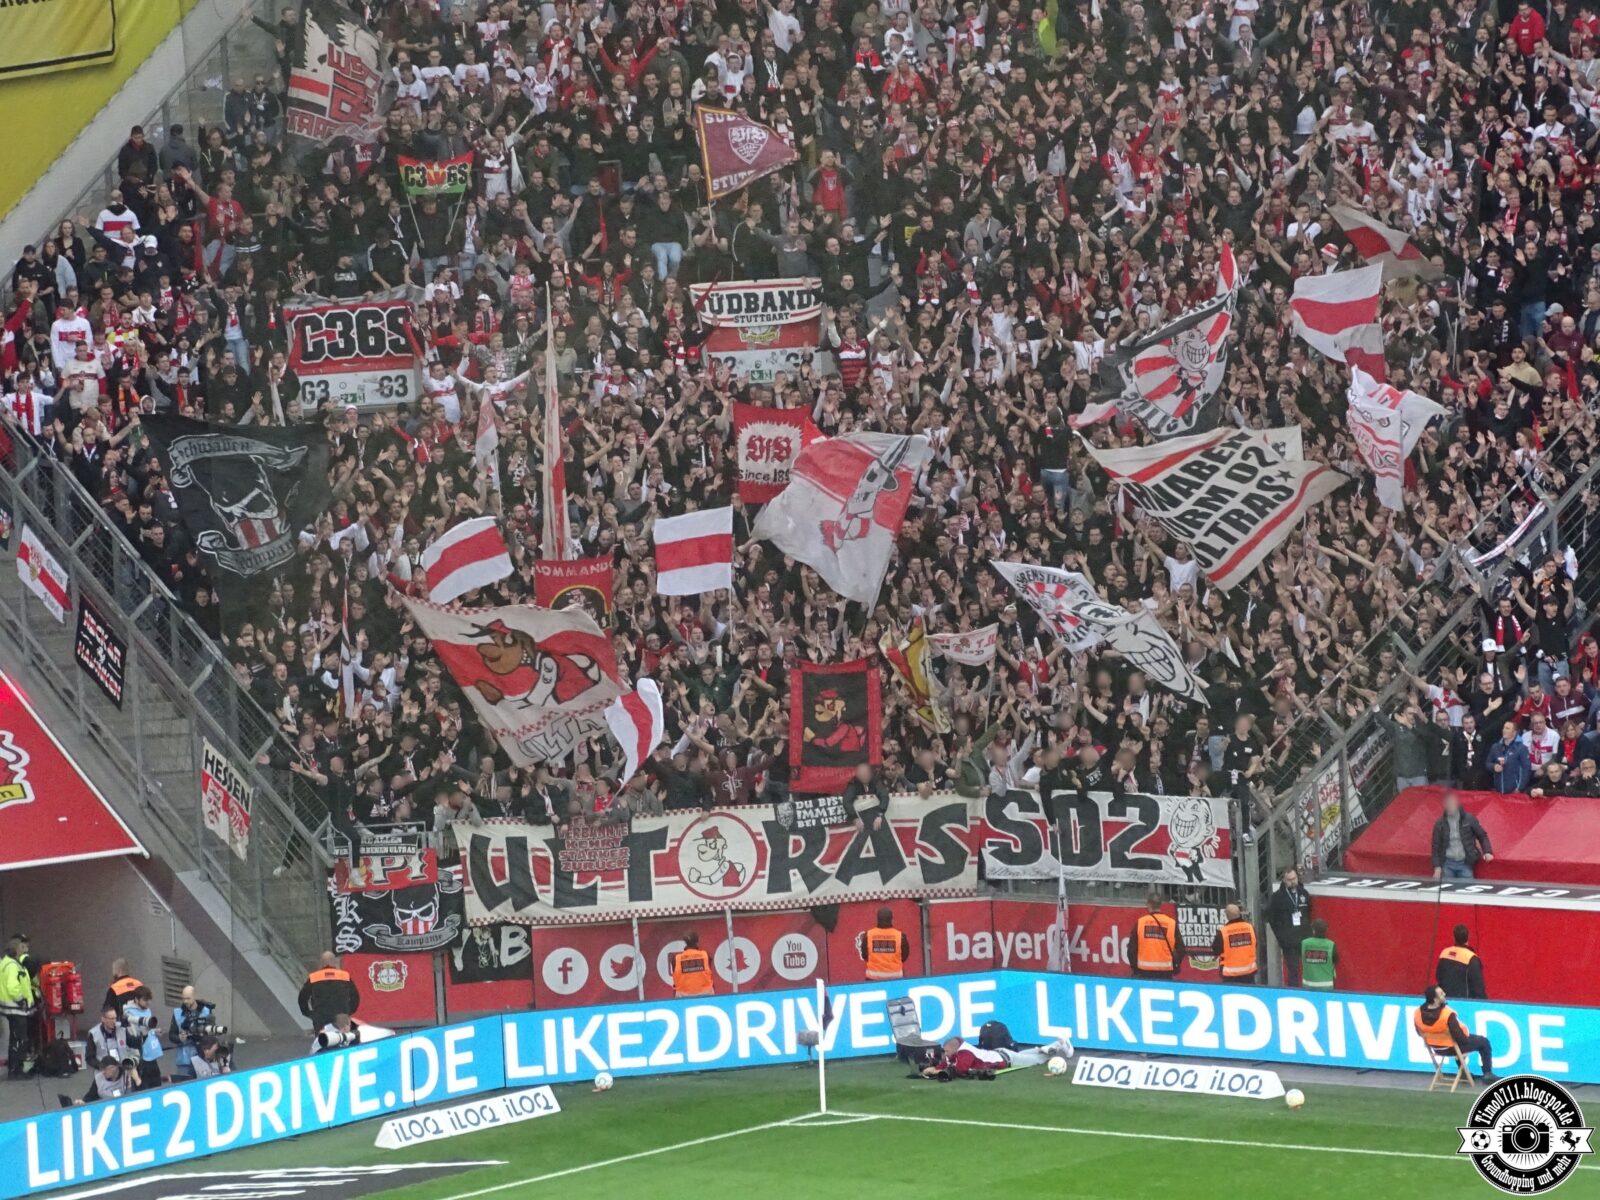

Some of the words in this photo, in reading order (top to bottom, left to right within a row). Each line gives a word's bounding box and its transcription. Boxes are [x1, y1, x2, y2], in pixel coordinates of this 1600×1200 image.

[734, 312, 790, 323] STUTTGART
[301, 379, 330, 404] G3
[1189, 475, 1295, 570] ULTRAS
[204, 749, 251, 813] HESSEN
[795, 800, 813, 810] DU
[818, 796, 843, 807] BIST
[796, 804, 846, 820] IMMER
[797, 819, 816, 828] BEI
[821, 815, 848, 825] UNS!
[390, 846, 416, 855] ULTRAS
[1310, 876, 1571, 898] CASTORE
[786, 941, 802, 951] You
[784, 953, 806, 968] Tube
[1079, 1059, 1131, 1086] iLOQ
[1143, 1064, 1199, 1089] iLOQ
[1209, 1069, 1263, 1095] iLOQ
[391, 1116, 443, 1142] iLOQ
[447, 1104, 500, 1131] iLOQ
[502, 1091, 554, 1118] iLOQ
